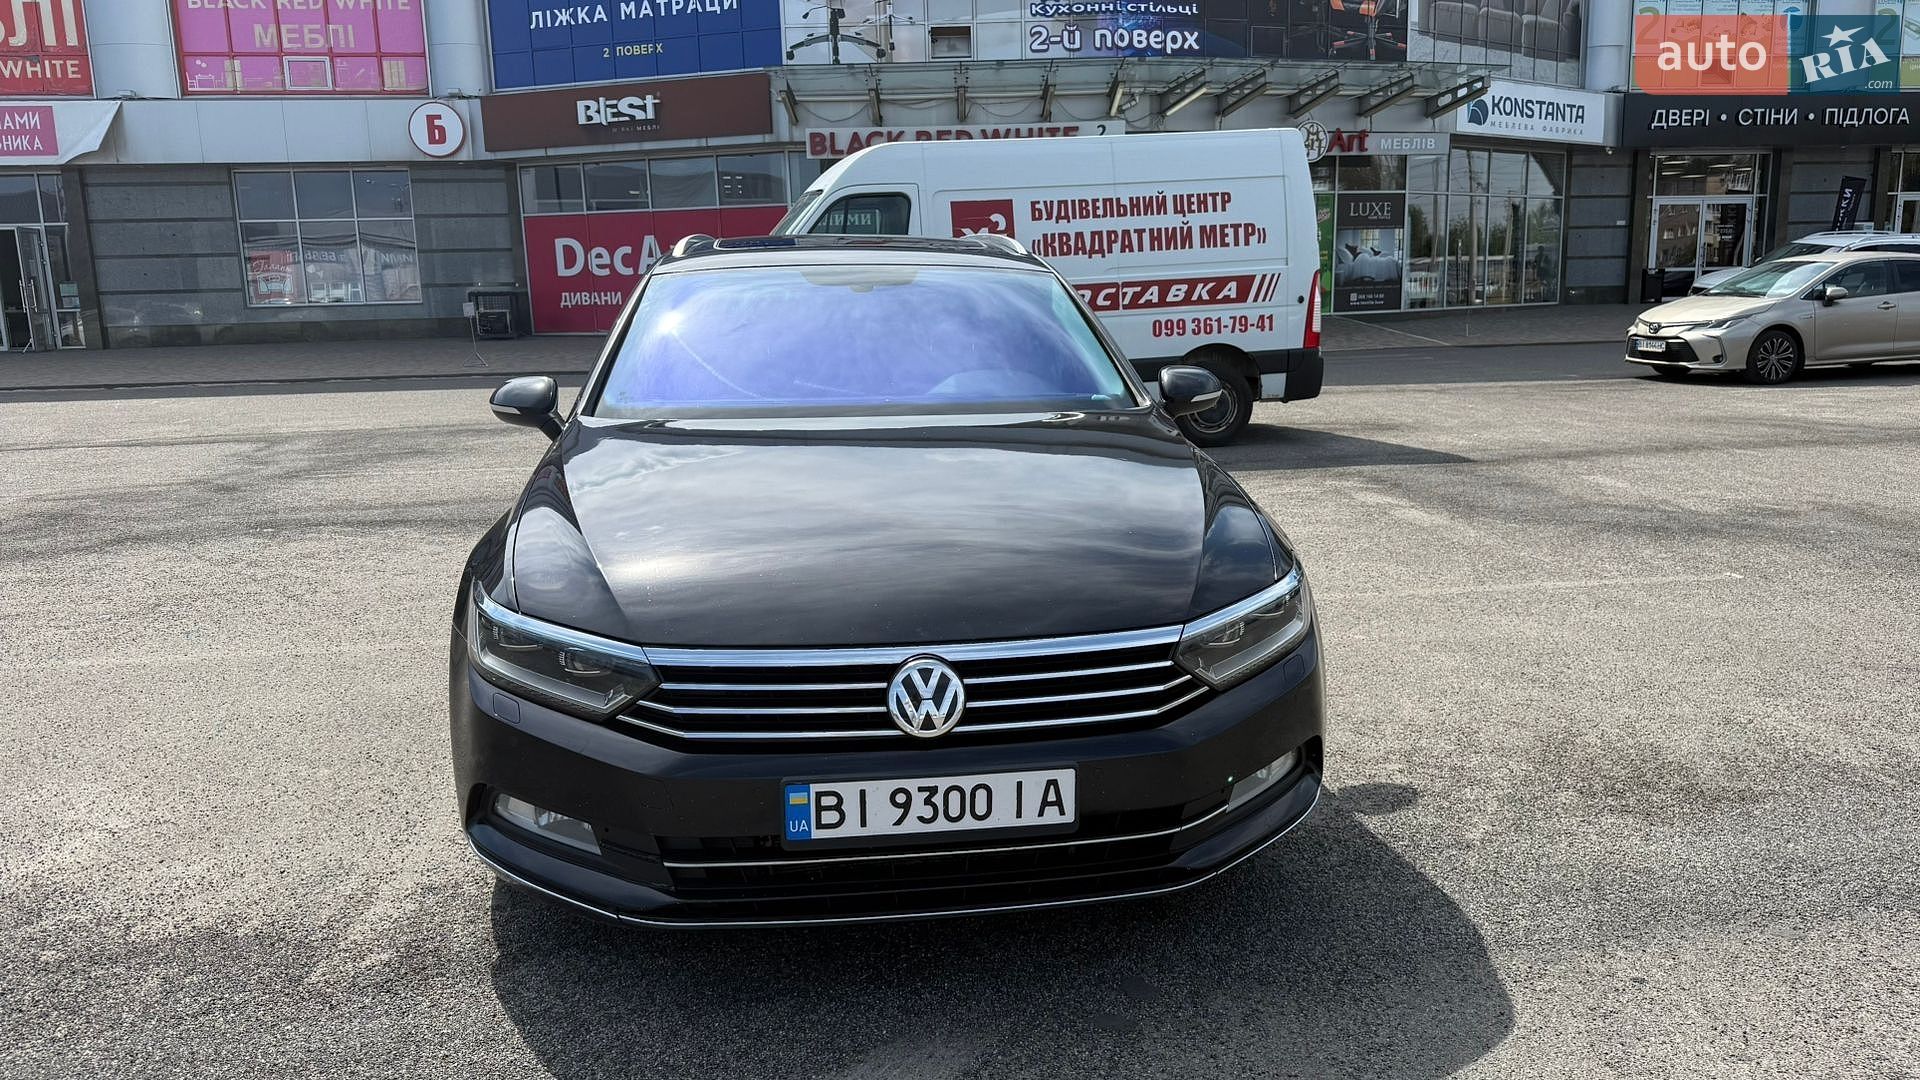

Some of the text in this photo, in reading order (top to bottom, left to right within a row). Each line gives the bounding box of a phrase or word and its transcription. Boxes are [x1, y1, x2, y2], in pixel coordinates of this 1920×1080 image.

[530, 4, 608, 30] ЛІЖКА
[1031, 1, 1199, 16] Кухонні стільці
[0, 0, 79, 46] ЛІ
[253, 23, 356, 49] МЕБЛІ
[1030, 25, 1200, 54] 2-й поверх
[603, 43, 664, 58] 2 ПОВЕРХ
[0, 60, 82, 78] WHITE
[0, 111, 41, 130] АМИ
[1491, 95, 1585, 125] KONSTANTA
[1651, 107, 1910, 129] ДВЕРІ СТІНИ ПІДЛОГА
[426, 114, 447, 145] Б
[1327, 128, 1436, 153] Art МЕБЛІВ
[1030, 190, 1232, 223] БУДІВЕЛЬНИЙ ЦЕНТР
[1349, 202, 1393, 217] LUXE
[1031, 220, 1194, 259] «КВАДРАТНИЙ
[1199, 222, 1267, 249] МЕТР»
[554, 235, 663, 277] DecA
[560, 291, 622, 309] ДИВАНИ
[1152, 314, 1274, 338] 099 361-79-41
[815, 778, 1066, 830] BI 9300 IA
[790, 819, 809, 833] UA
